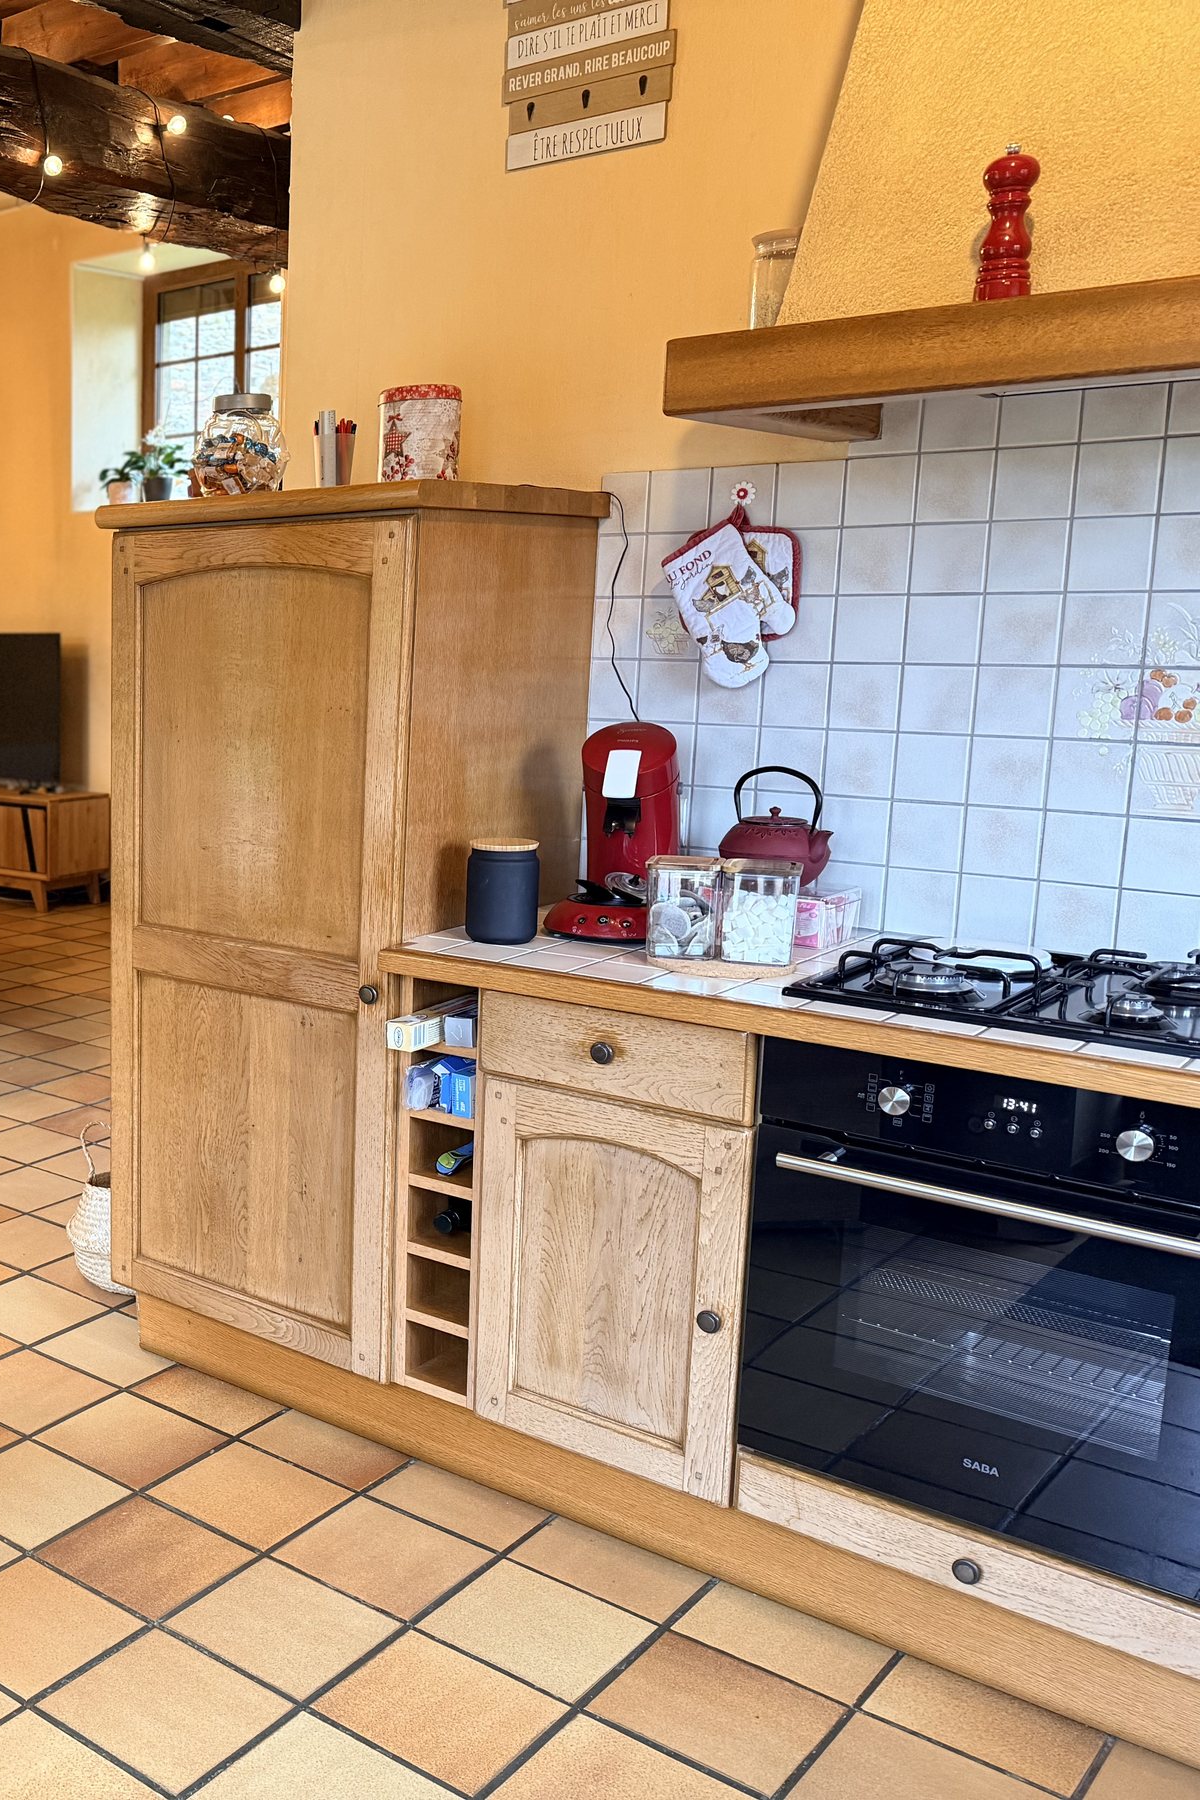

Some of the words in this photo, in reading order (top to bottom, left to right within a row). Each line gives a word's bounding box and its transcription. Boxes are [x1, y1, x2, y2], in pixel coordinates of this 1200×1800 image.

[552, 3, 566, 20] les
[570, 4, 587, 16] uns
[518, 35, 540, 59] DIRE
[543, 31, 561, 53] S'IL
[566, 26, 575, 46] TE
[579, 15, 607, 43] PLAÎT
[611, 13, 623, 35] ET
[625, 3, 659, 31] MERCI
[585, 55, 610, 74] RIRE
[612, 40, 671, 68] BEAUCOUP
[533, 132, 557, 161] ÊTRE
[562, 116, 643, 155] RESPECTUEUX
[679, 550, 712, 575] FOND
[963, 1458, 999, 1477] SABA
